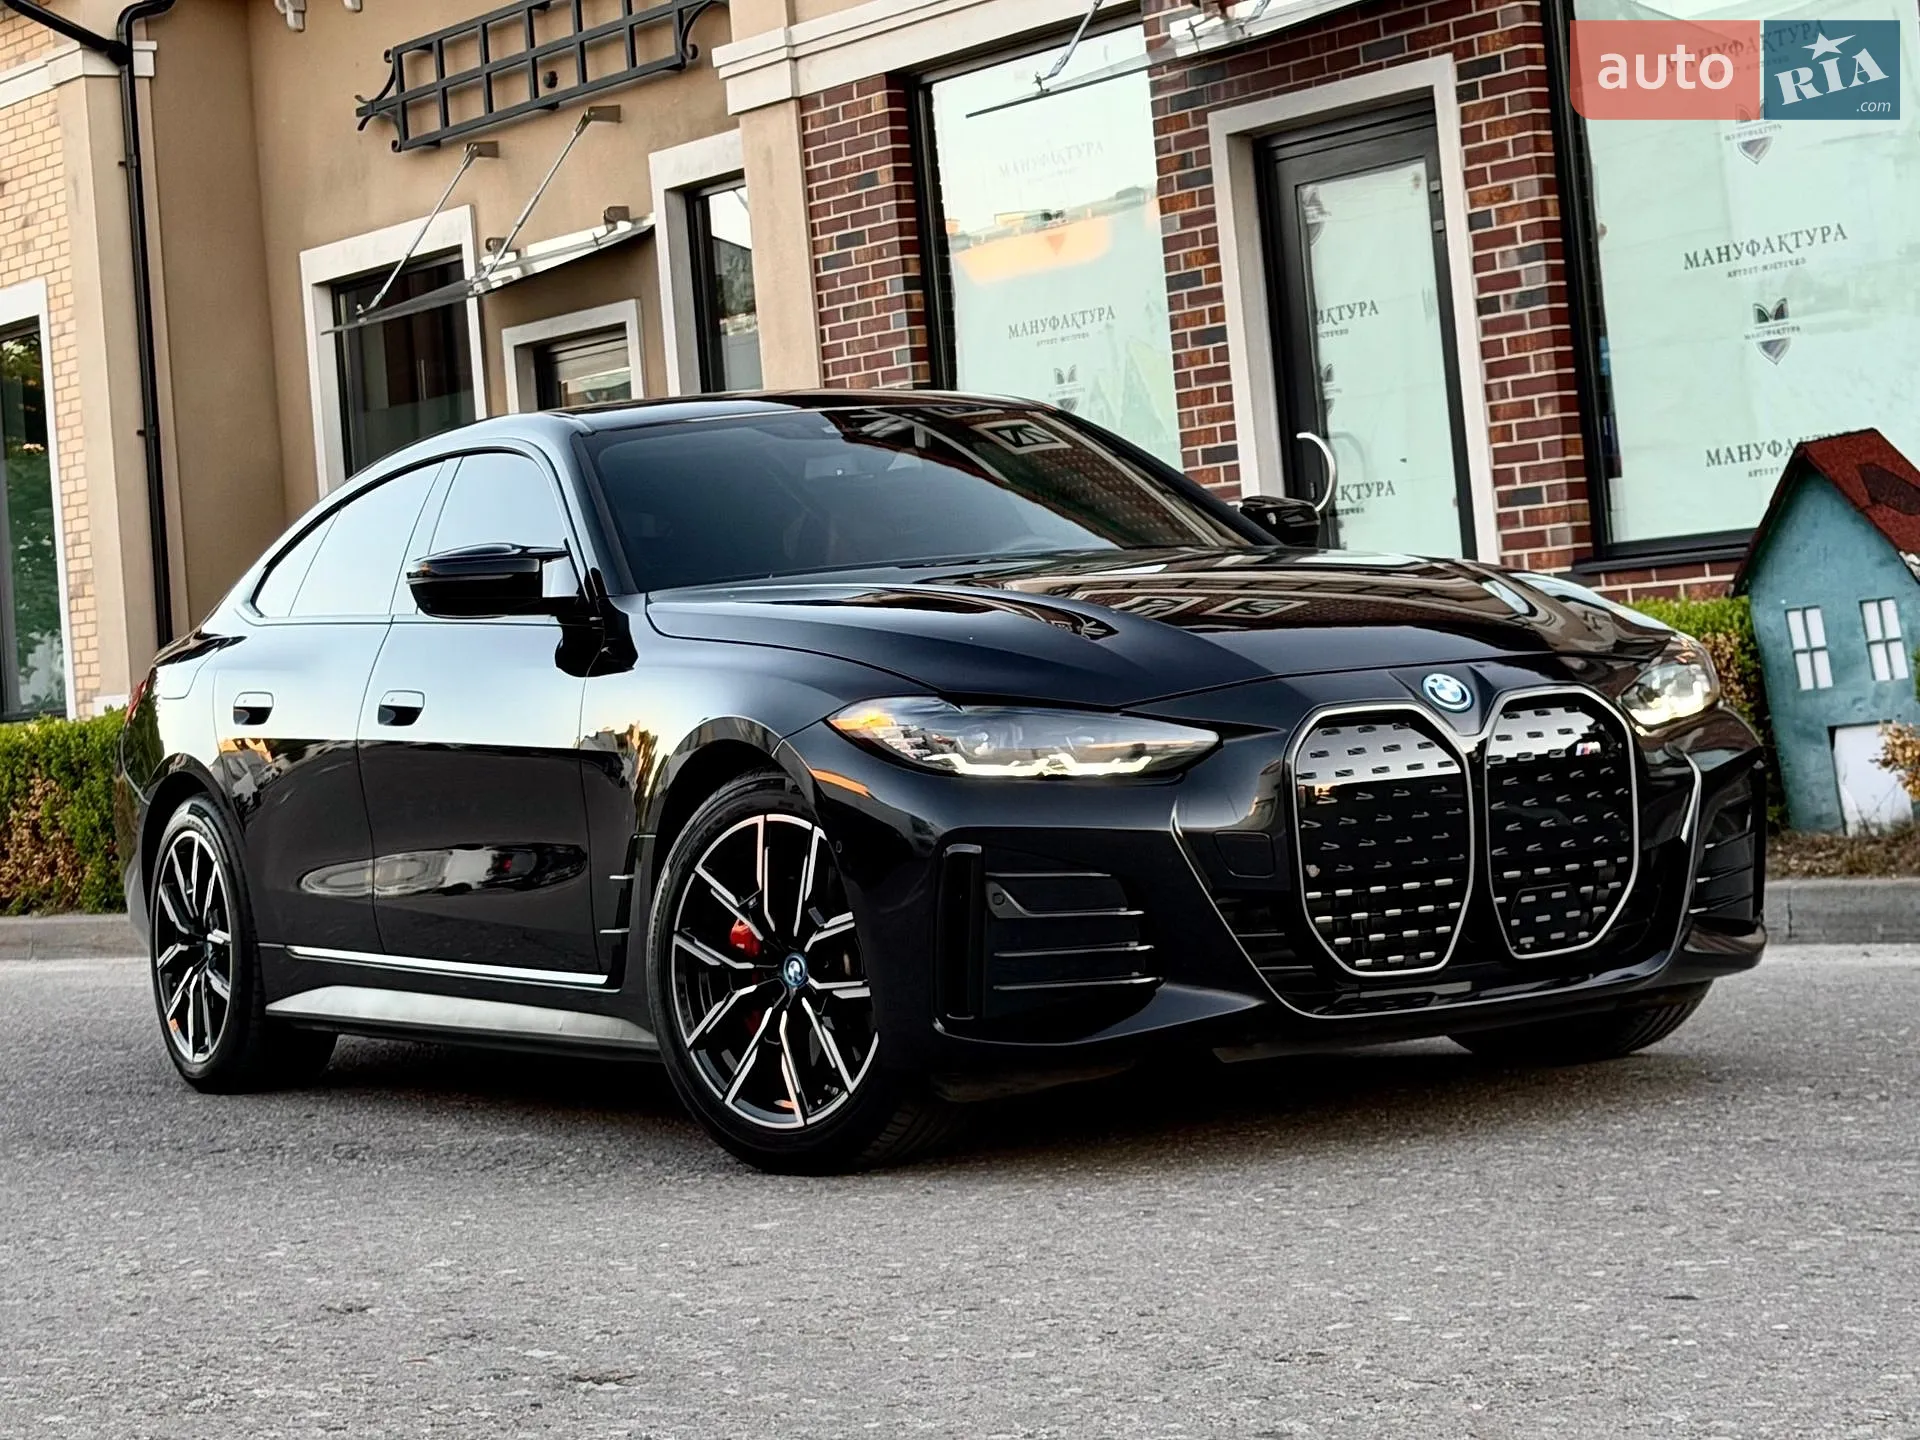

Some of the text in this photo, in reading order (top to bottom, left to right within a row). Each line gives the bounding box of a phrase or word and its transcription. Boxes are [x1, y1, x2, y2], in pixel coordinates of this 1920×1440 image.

[1683, 222, 1848, 270] МАНУФАКТУРА
[1008, 304, 1116, 340] МАНУФАКТУРА
[1706, 434, 1828, 467] МАНУФА
[1336, 480, 1396, 504] КТУРА
